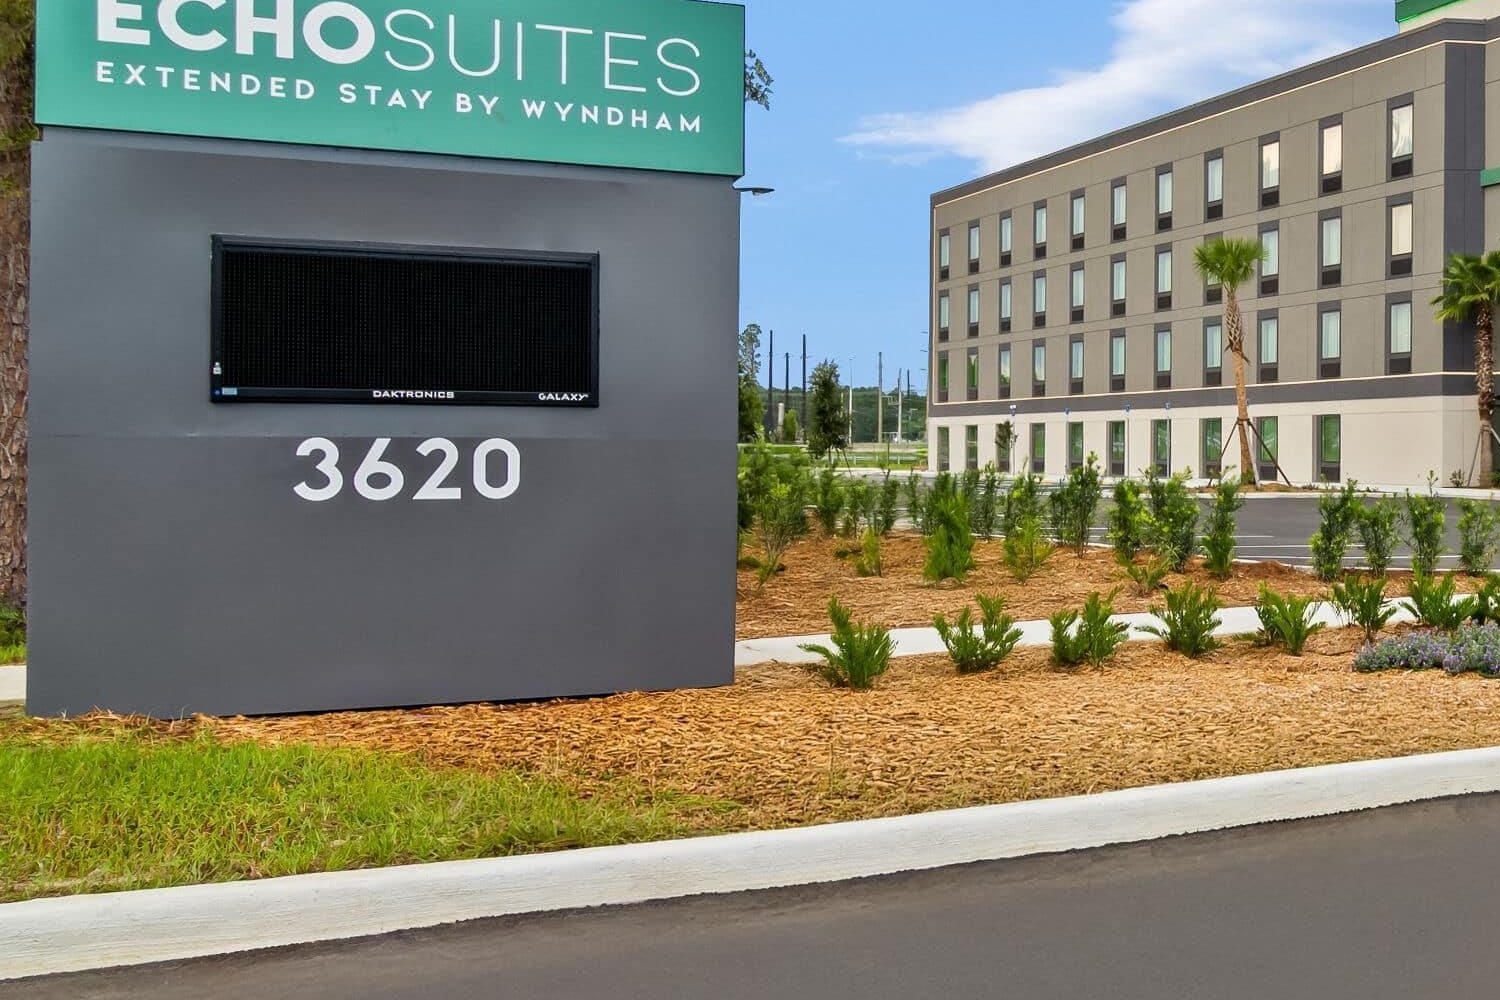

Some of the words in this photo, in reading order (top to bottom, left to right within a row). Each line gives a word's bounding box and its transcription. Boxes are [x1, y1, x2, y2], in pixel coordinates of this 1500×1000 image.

[96, 60, 315, 100] EXTENDED
[339, 83, 433, 110] STAY
[455, 93, 500, 116] BY
[522, 99, 701, 133] WYNDHAM
[372, 390, 455, 399] DAKTRONICS
[538, 392, 587, 401] GALAXY
[293, 437, 521, 502] 3620
